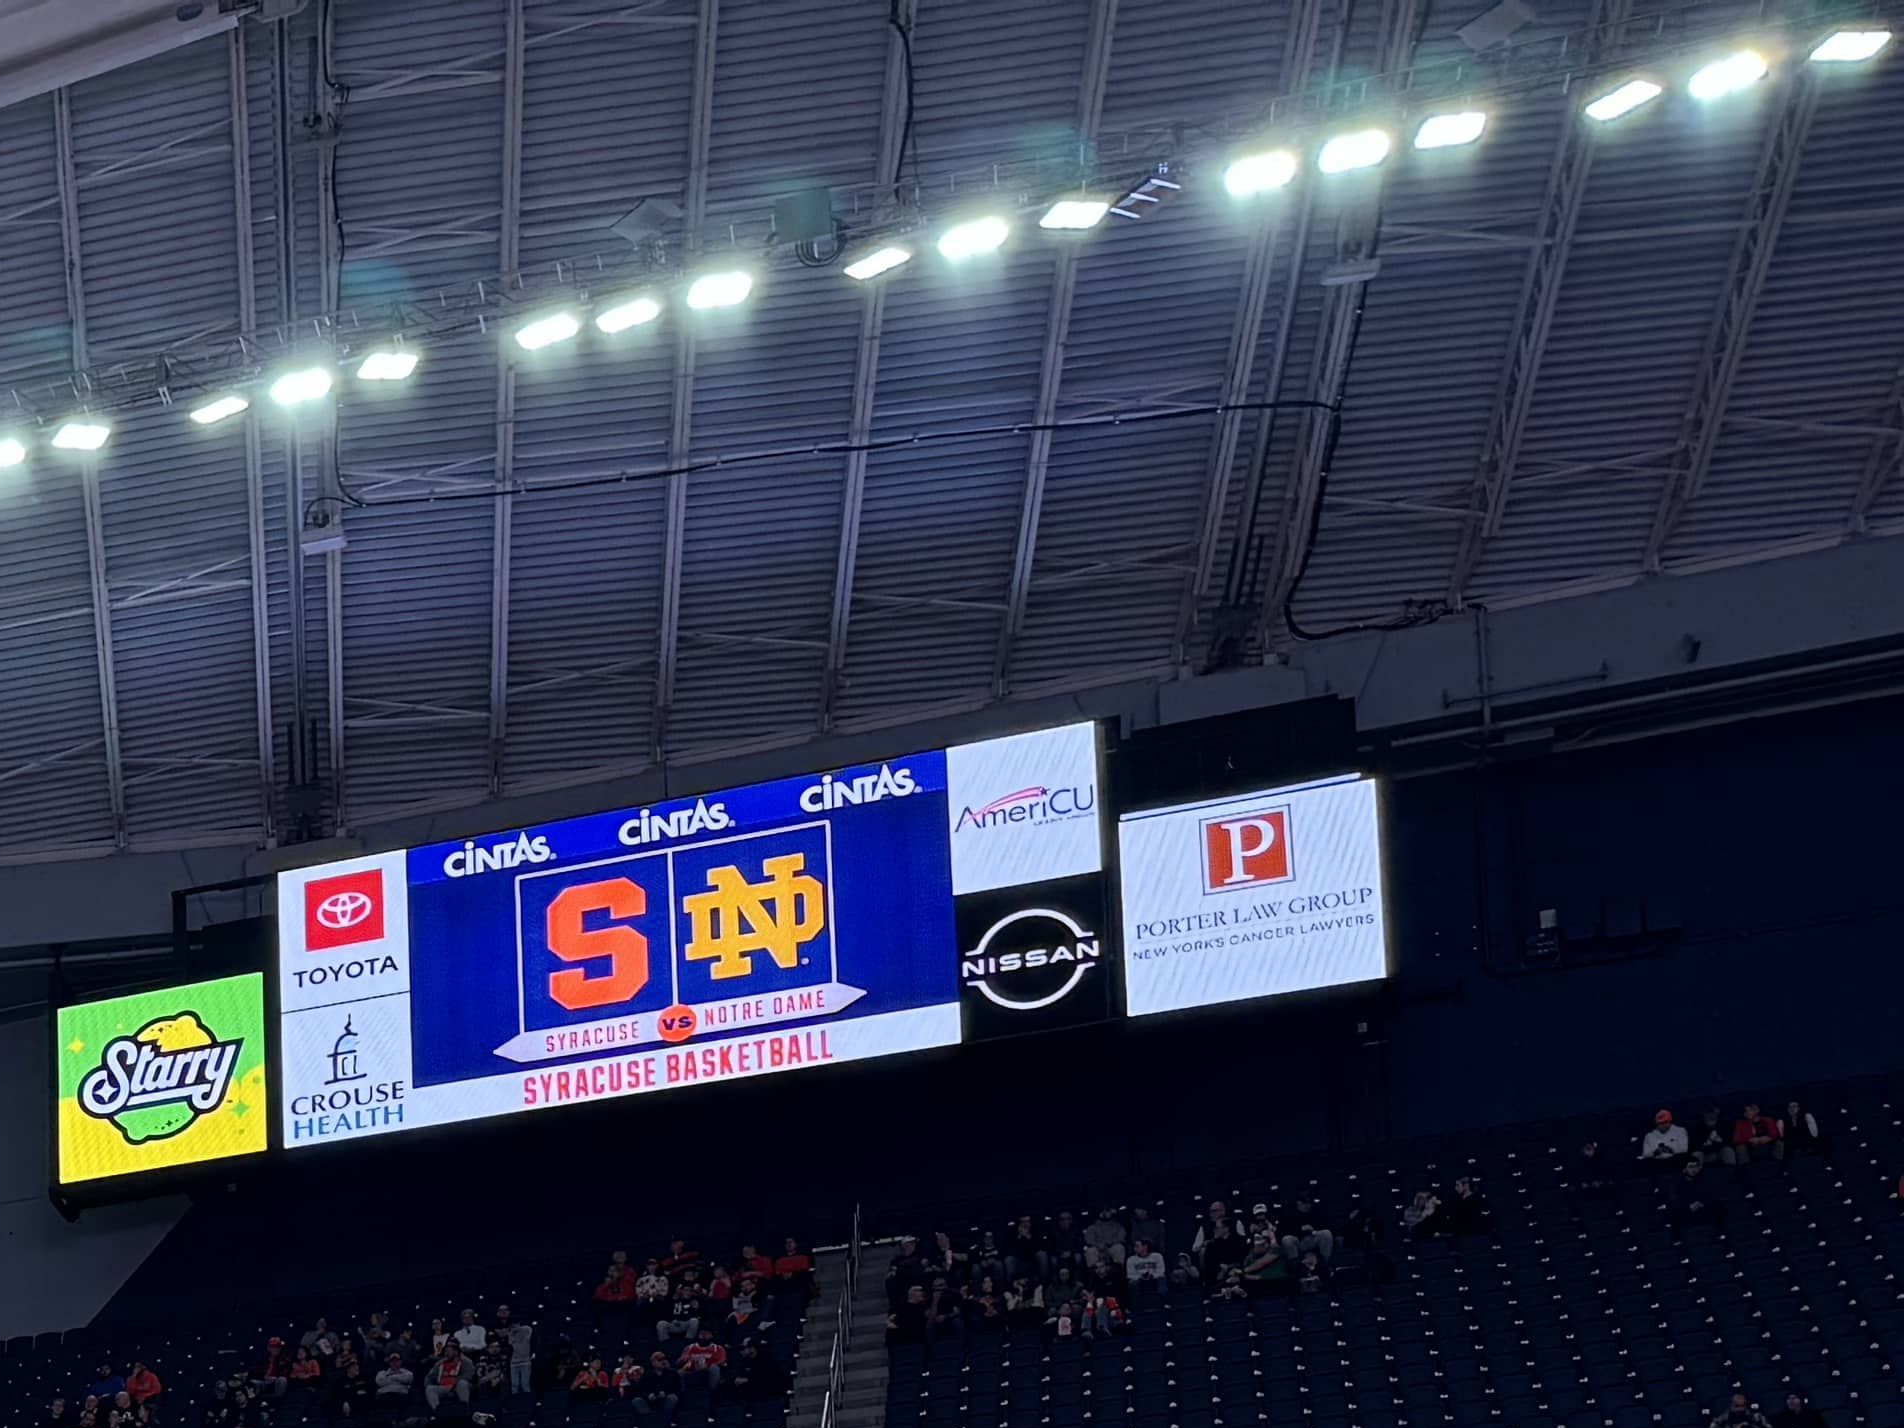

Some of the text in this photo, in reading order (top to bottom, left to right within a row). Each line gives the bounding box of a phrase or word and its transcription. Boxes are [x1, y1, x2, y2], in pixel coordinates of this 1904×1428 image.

[954, 783, 1096, 833] AmeriCU
[1221, 818, 1276, 885] P
[1132, 913, 1375, 961] NEW CANCER LAWYERS
[1135, 887, 1374, 941] PORTER LAW GROUP
[546, 876, 649, 1010] S
[962, 937, 1100, 979] NISSAN
[293, 953, 399, 988] TOYOTA
[704, 988, 827, 1026] NOTRE DAME
[545, 1020, 641, 1054] SYRACUSE
[80, 1038, 236, 1113] Starry
[290, 1079, 405, 1117] CROUSE
[523, 1056, 659, 1106] SYRACUSE
[294, 1103, 404, 1140] HEALTH
